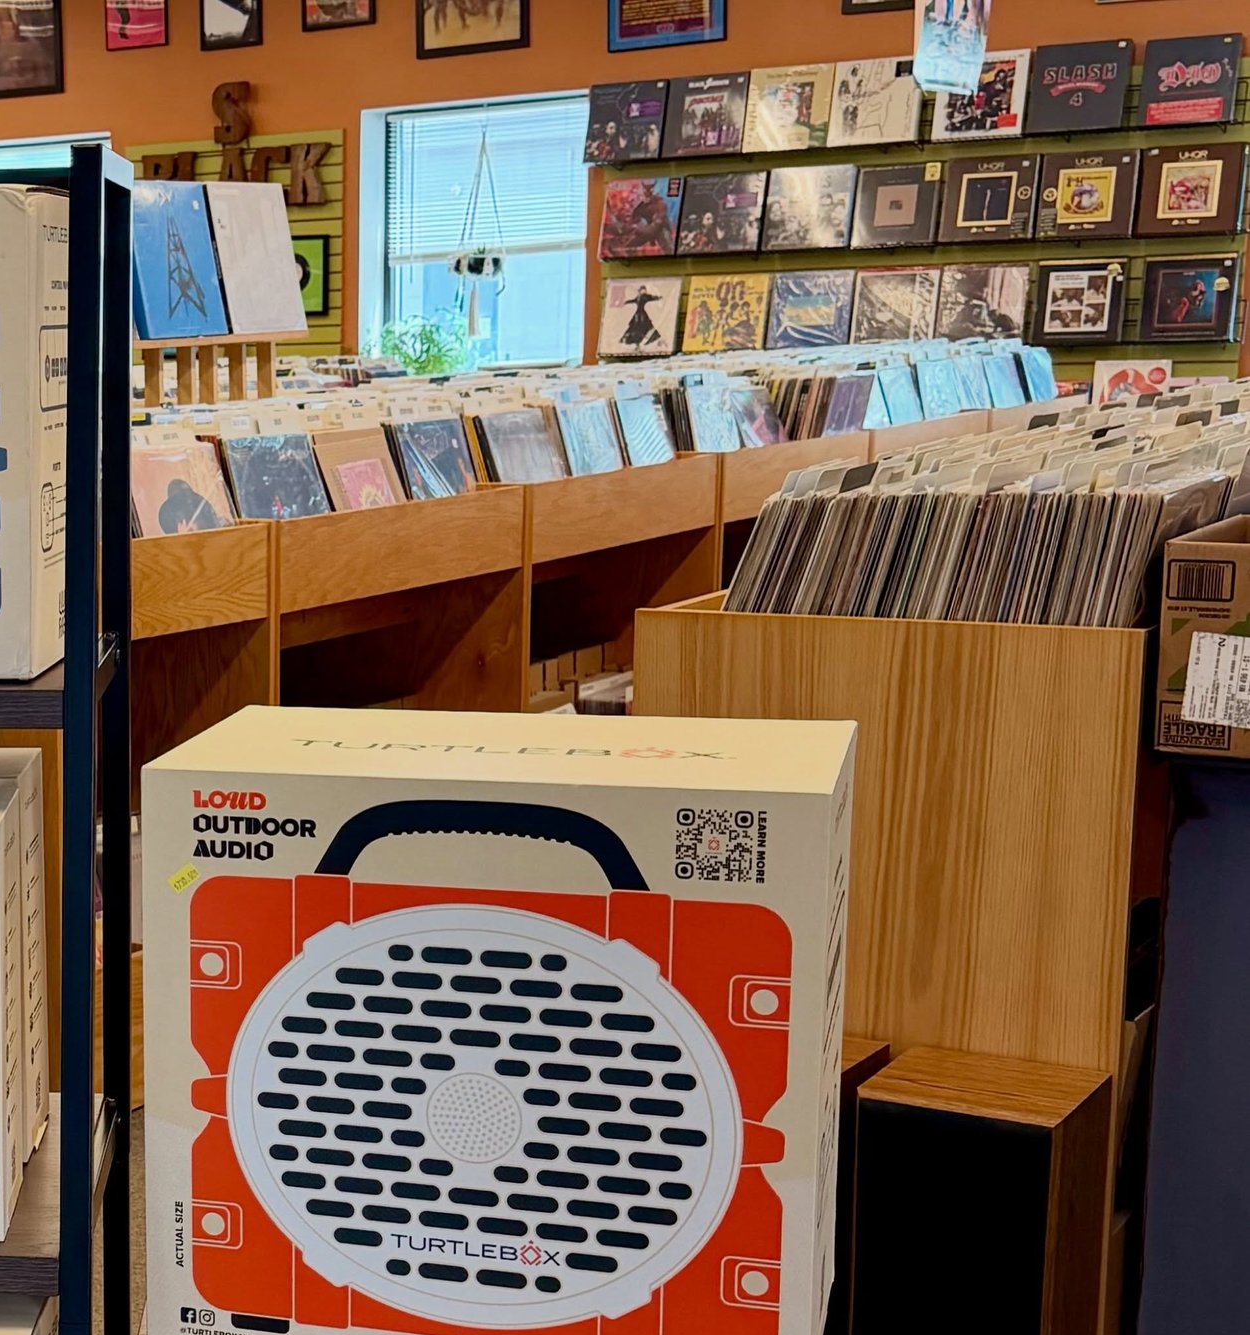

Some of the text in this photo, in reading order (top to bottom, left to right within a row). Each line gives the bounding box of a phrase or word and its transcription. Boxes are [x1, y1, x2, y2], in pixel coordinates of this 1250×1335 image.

[1043, 62, 1118, 84] SLASH
[42, 225, 68, 244] TURTLEB
[1164, 722, 1226, 738] FRAGILE
[293, 738, 730, 760] TURTLEBOX
[192, 789, 267, 811] LOUD
[193, 814, 316, 838] OUTDOOR
[193, 839, 274, 861] AUDIO
[757, 811, 766, 884] LEARN MORE
[175, 1200, 184, 1267] ACTUAL SIZE
[390, 1232, 561, 1266] TURTLEBOX
